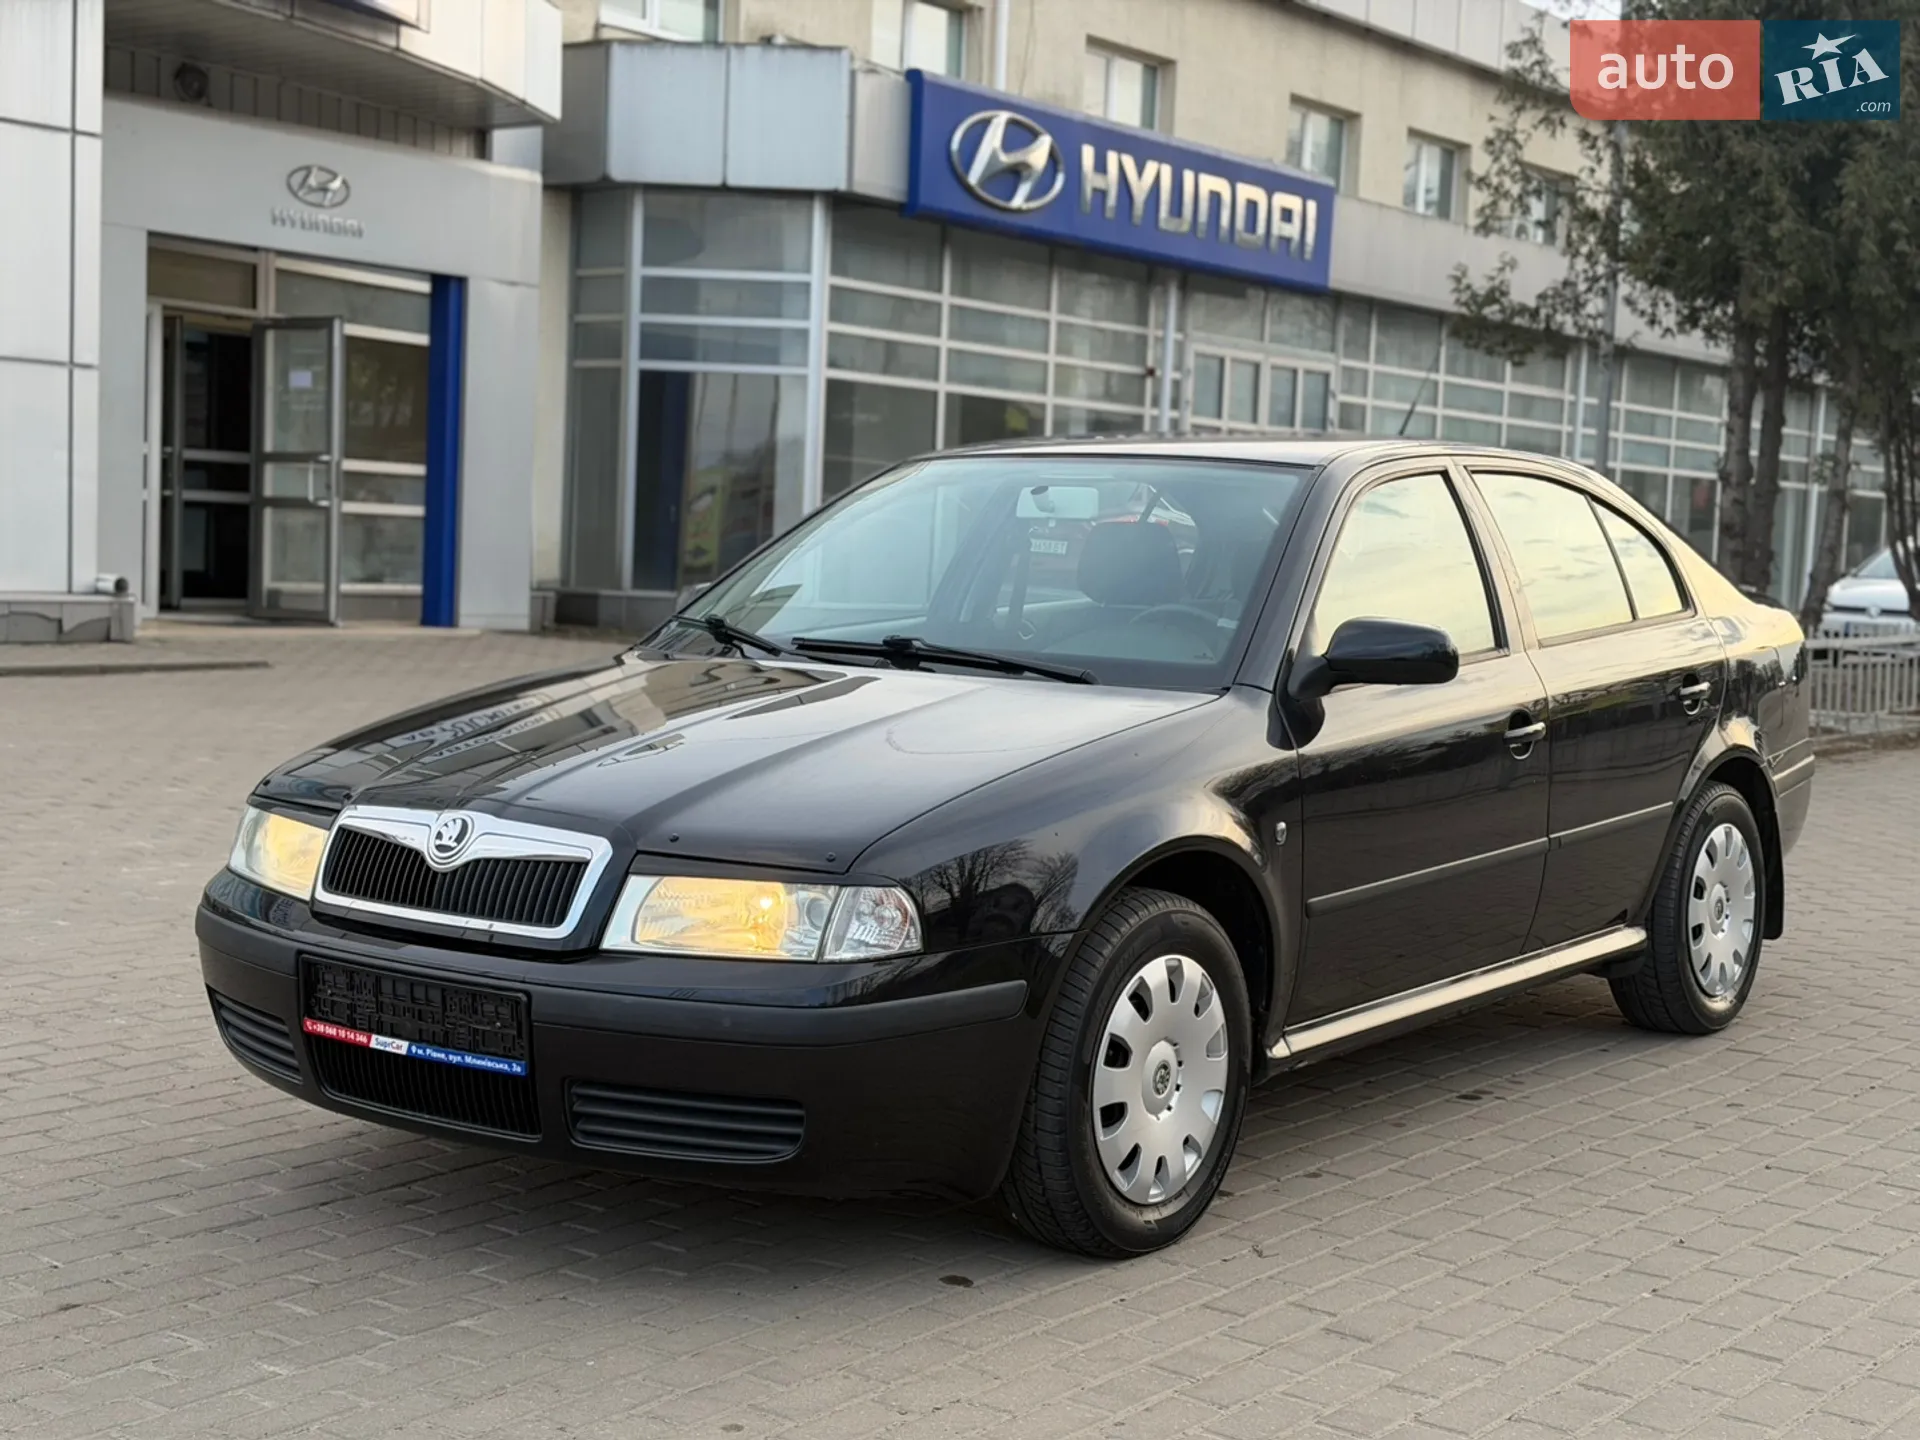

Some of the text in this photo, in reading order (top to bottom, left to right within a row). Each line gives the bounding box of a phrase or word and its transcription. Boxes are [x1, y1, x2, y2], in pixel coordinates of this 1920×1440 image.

[1081, 143, 1317, 261] HYUNDAI
[270, 206, 365, 239] HYUNDAI
[374, 1036, 403, 1052] SuprCar
